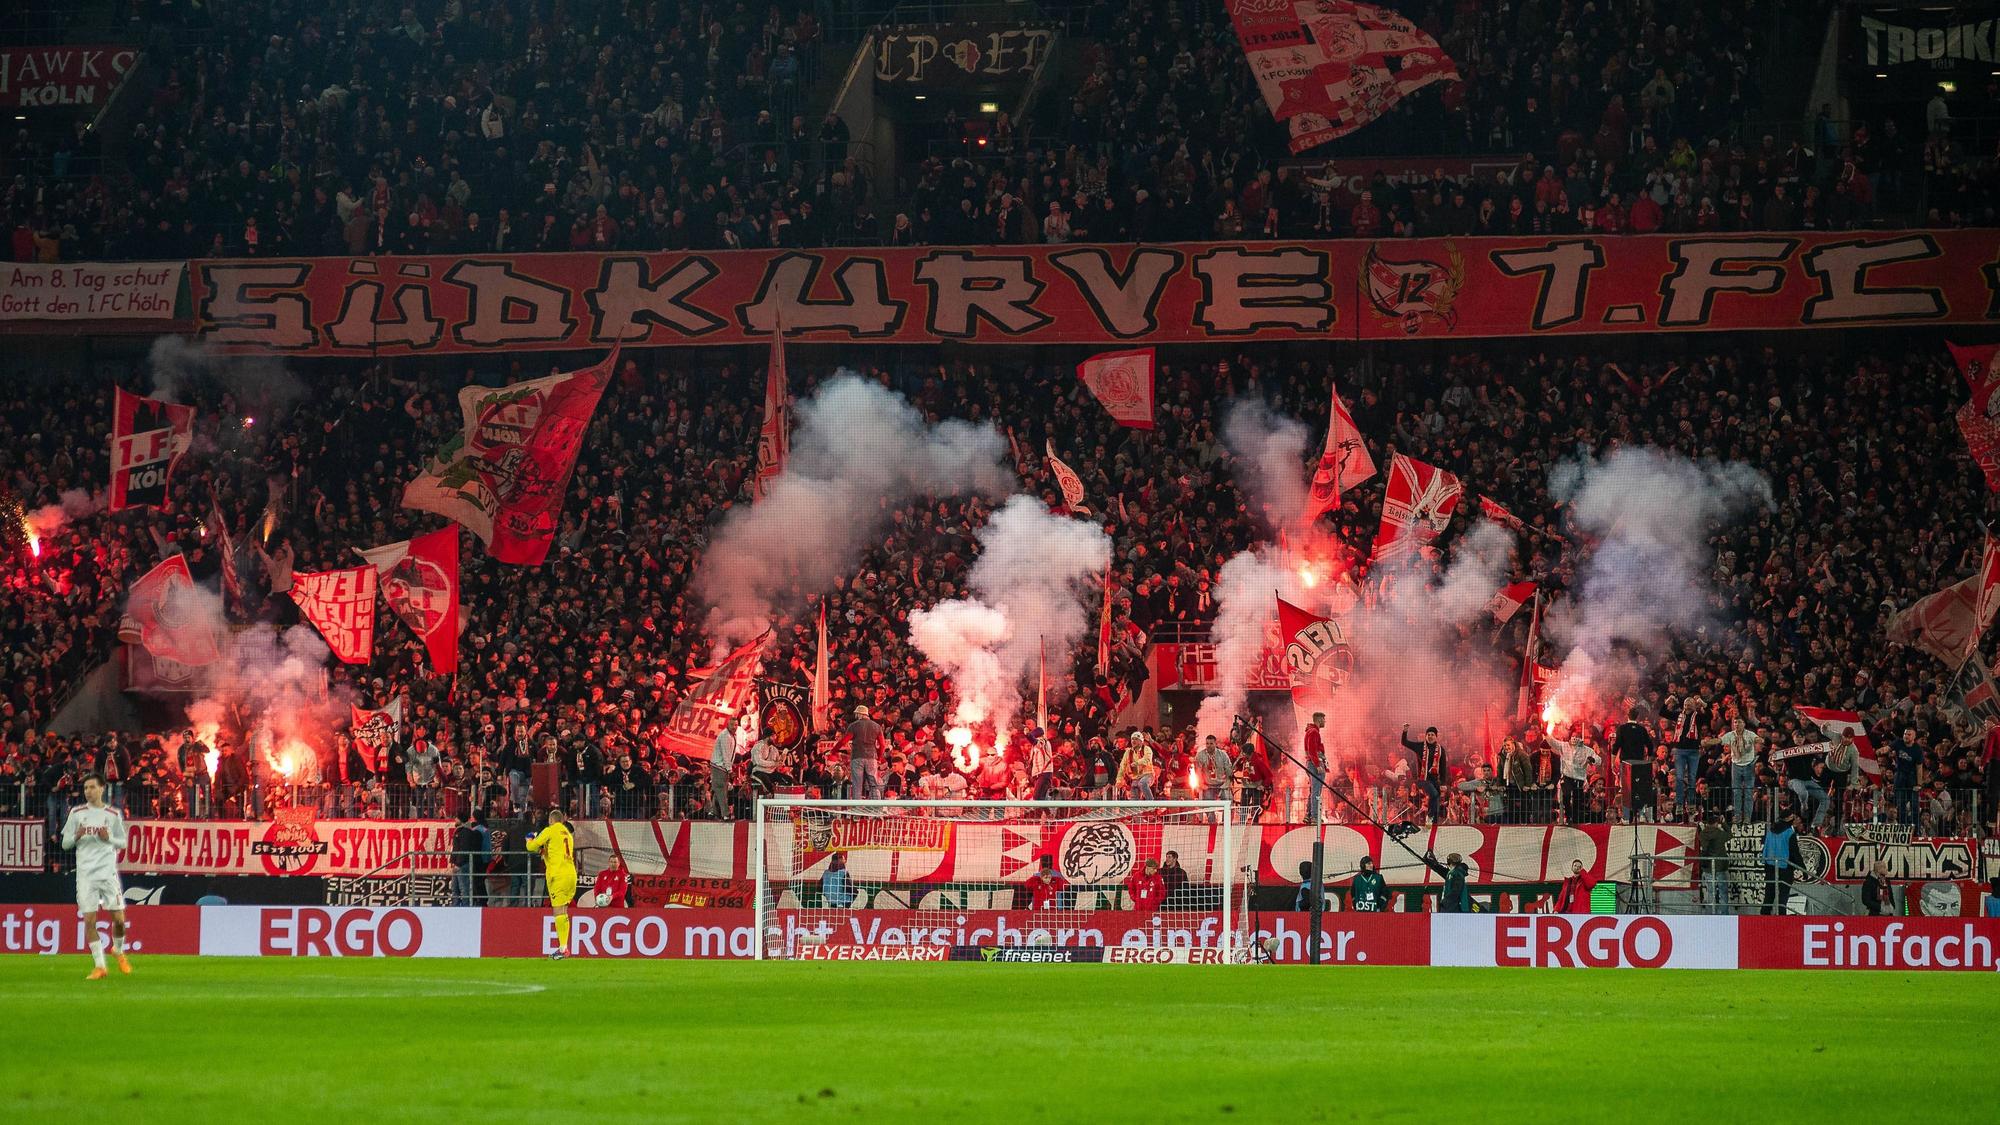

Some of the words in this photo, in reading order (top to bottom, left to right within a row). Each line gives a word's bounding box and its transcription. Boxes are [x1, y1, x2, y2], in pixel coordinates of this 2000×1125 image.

[1861, 16, 2000, 66] TROIK
[20, 83, 95, 106] KÖLN
[11, 269, 43, 288] Am
[50, 269, 66, 288] 8.
[73, 269, 105, 291] Tag
[113, 268, 170, 287] schuf
[1397, 271, 1431, 304] 12
[2, 295, 40, 313] Gott
[46, 295, 79, 313] den
[128, 290, 170, 312] Köln
[202, 247, 1337, 349] SÜDKURVE
[119, 431, 177, 466] 1.F
[129, 465, 167, 491] KÖL
[0, 824, 43, 867] ELIS
[330, 828, 455, 871] SYNDIKA
[1160, 823, 1699, 888] HORDE
[1839, 844, 1969, 879] COLONIACS
[3, 909, 60, 955] tig
[260, 908, 423, 957] ERGO
[542, 915, 669, 956] ERGO
[1496, 916, 1673, 968] ERGO
[800, 945, 946, 961] FLYERALARM
[1004, 949, 1072, 963] freenet
[1110, 949, 1174, 964] ERGO
